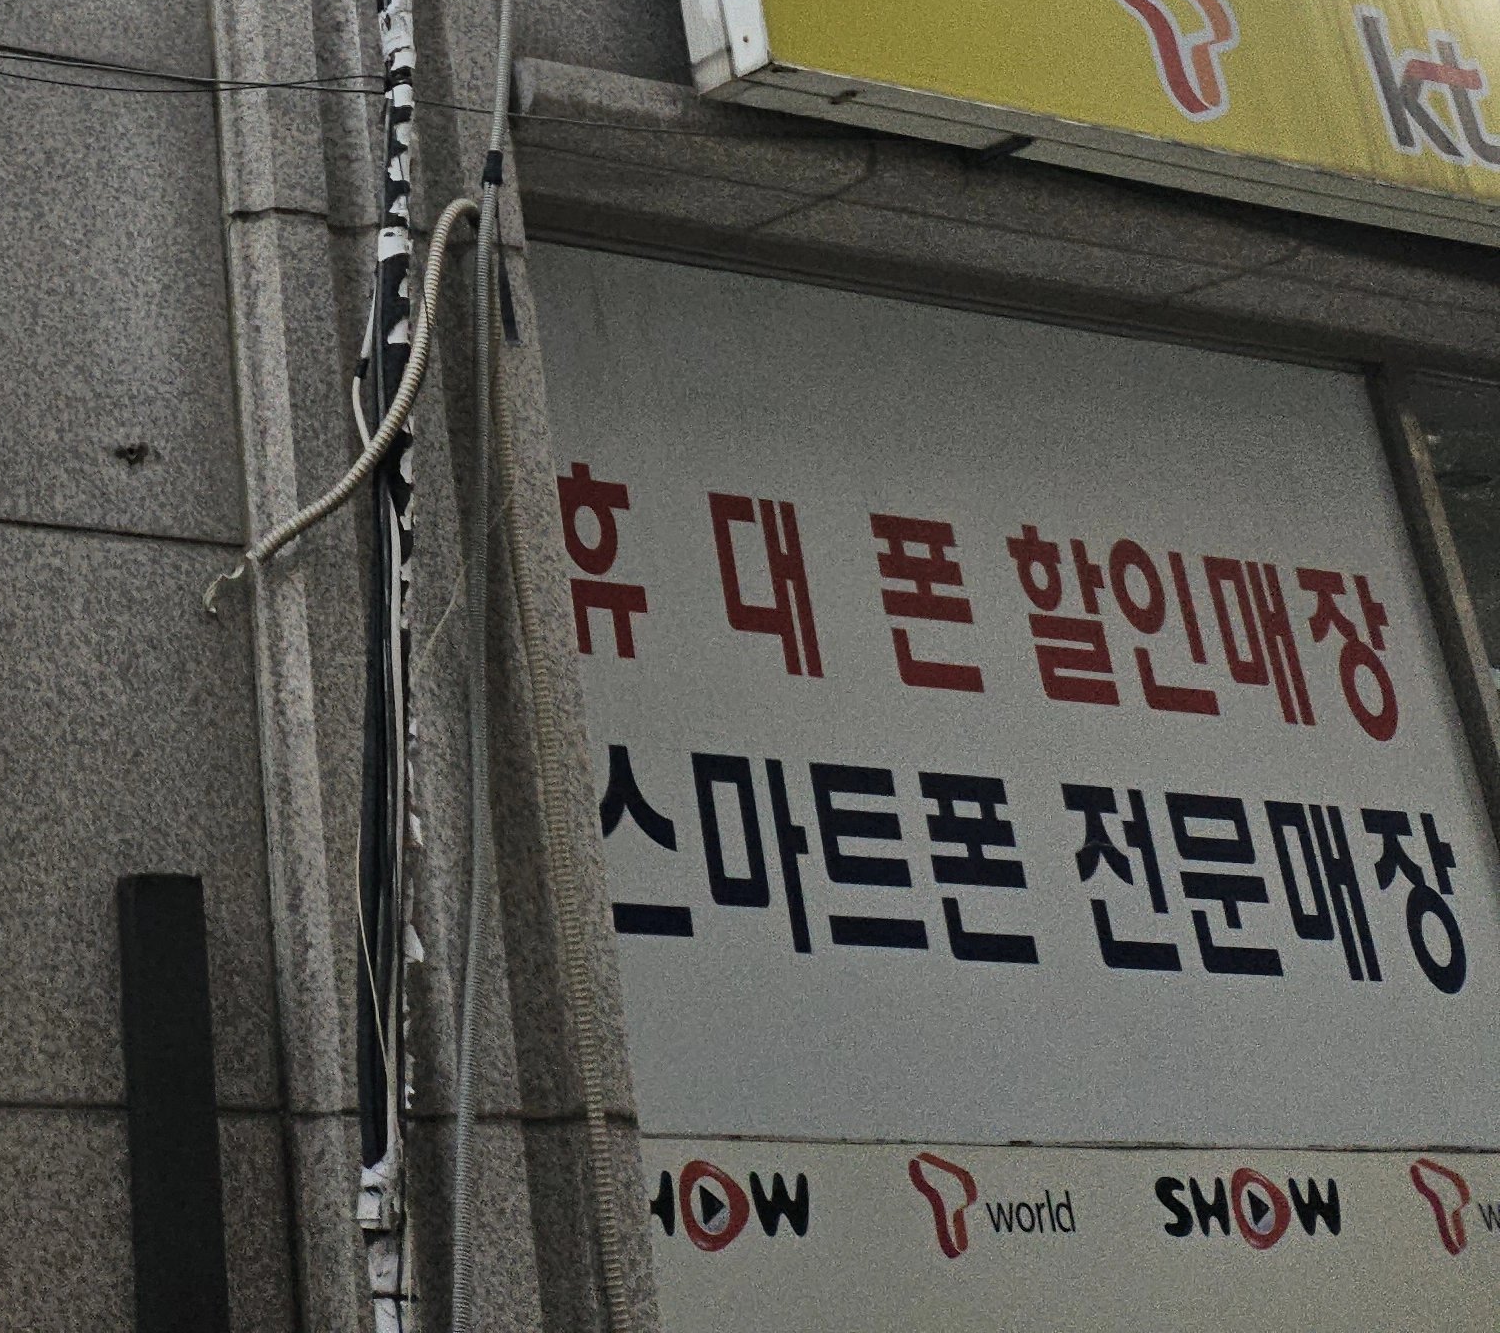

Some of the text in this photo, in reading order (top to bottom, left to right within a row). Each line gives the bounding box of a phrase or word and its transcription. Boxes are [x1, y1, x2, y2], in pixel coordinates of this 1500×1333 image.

[1358, 8, 1500, 168] kt
[1006, 524, 1398, 742] 할인매장
[602, 745, 1468, 995] 스마트폰 전문매장
[985, 1189, 1076, 1234] world
[1155, 1167, 1342, 1250] SHOW
